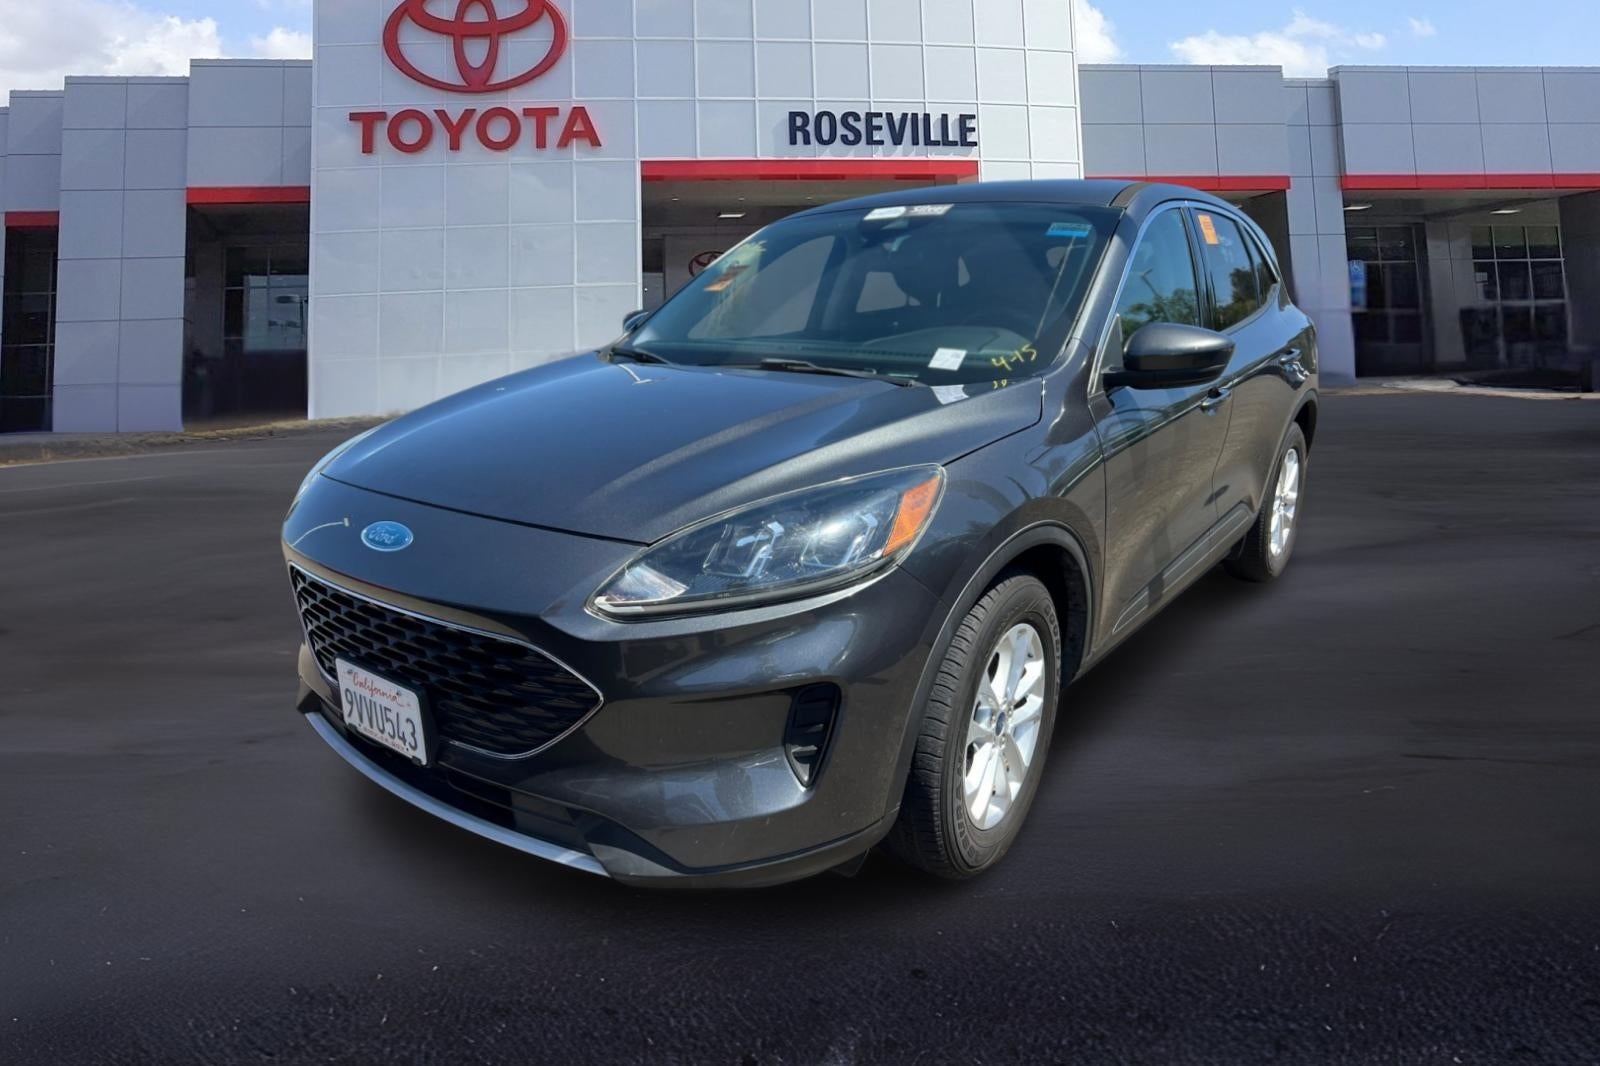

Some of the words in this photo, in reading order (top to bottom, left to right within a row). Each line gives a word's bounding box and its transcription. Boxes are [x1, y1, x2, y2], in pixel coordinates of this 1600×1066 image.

[349, 106, 602, 153] TOYOTA
[788, 111, 978, 147] ROSEVILLE
[352, 671, 405, 707] California
[344, 687, 418, 752] 9VVU543
